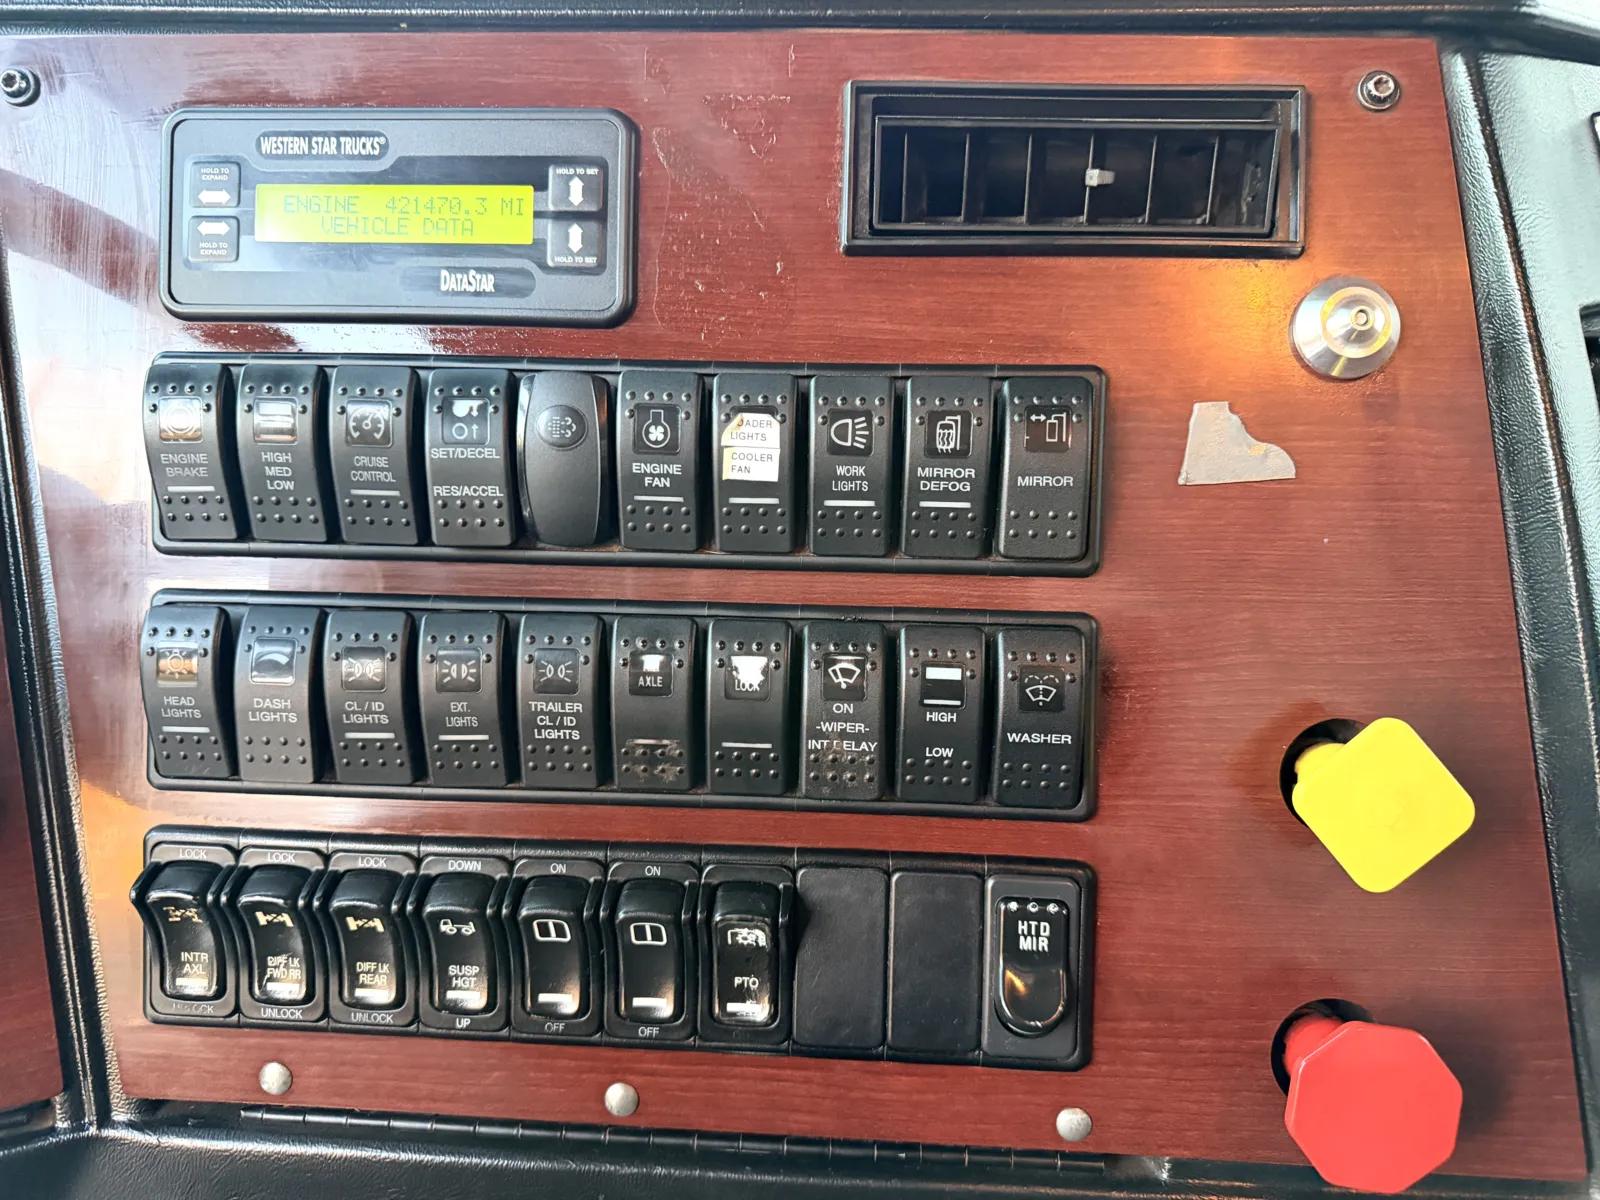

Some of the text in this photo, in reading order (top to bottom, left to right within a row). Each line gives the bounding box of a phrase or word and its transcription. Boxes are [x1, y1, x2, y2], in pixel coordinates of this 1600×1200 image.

[260, 137, 309, 155] WESTERN
[312, 137, 337, 155] STAR
[283, 195, 524, 216] ENGINE 421470.3 MI
[321, 216, 474, 236] VEHICLE DATA
[731, 431, 767, 441] LIGHTS
[161, 454, 208, 464] ENGINE
[261, 452, 292, 462] HIGH
[431, 448, 500, 459] SET/DECEL
[732, 452, 773, 462] COOLER
[354, 456, 388, 468] CRUISE
[166, 467, 208, 477] BRAKE
[266, 467, 292, 477] MED
[632, 463, 682, 475] ENGINE
[731, 465, 751, 474] FAN
[836, 465, 866, 477] WORK
[918, 467, 975, 479] MIRROR
[351, 470, 396, 483] CONTROL
[644, 477, 671, 487] FAN
[1018, 476, 1074, 487] MIRROR
[267, 480, 295, 491] LOW
[832, 481, 868, 492] LIGHTS
[920, 481, 970, 492] DEFOG
[433, 486, 504, 497] RES/ACCEL
[638, 676, 663, 688] AXLE
[735, 680, 760, 691] LOCK
[164, 696, 195, 705] HEAD
[253, 698, 291, 709] DASH
[345, 701, 362, 711] CL
[371, 702, 385, 712] ID
[450, 702, 471, 712] EXT.
[529, 701, 582, 713] TRAILER
[833, 703, 853, 713] ON
[161, 708, 202, 718] LIGHTS
[249, 712, 297, 723] LIGHTS
[343, 713, 389, 724] LIGHTS
[926, 712, 957, 722] HIGH
[446, 716, 478, 727] LIGHTS
[537, 716, 553, 726] CL
[563, 716, 576, 727] ID
[534, 729, 580, 740] LIGHTS
[1007, 732, 1072, 744] WASHER
[926, 748, 953, 757] LOW
[179, 849, 207, 859] LOCK
[267, 853, 295, 863] LOCK
[358, 857, 386, 868] LOCK
[448, 860, 481, 871] DOWN
[550, 863, 566, 873] ON
[645, 866, 661, 876] ON
[1018, 920, 1050, 936] HTD
[1019, 936, 1049, 952] MIR
[181, 952, 208, 963] INTR
[288, 957, 299, 967] LK
[183, 964, 205, 975] AXL
[267, 967, 301, 979] FWD RR
[357, 962, 389, 973] DIFF LK
[449, 965, 479, 976] SUSP
[359, 974, 386, 985] REAR
[452, 977, 476, 988] HGT
[734, 976, 759, 990] PTO
[261, 1008, 303, 1019] UNLOCK
[352, 1013, 393, 1023] UNLOCK
[456, 1018, 471, 1028] UP
[545, 1023, 565, 1033] OFF
[639, 1027, 659, 1037] OFF
